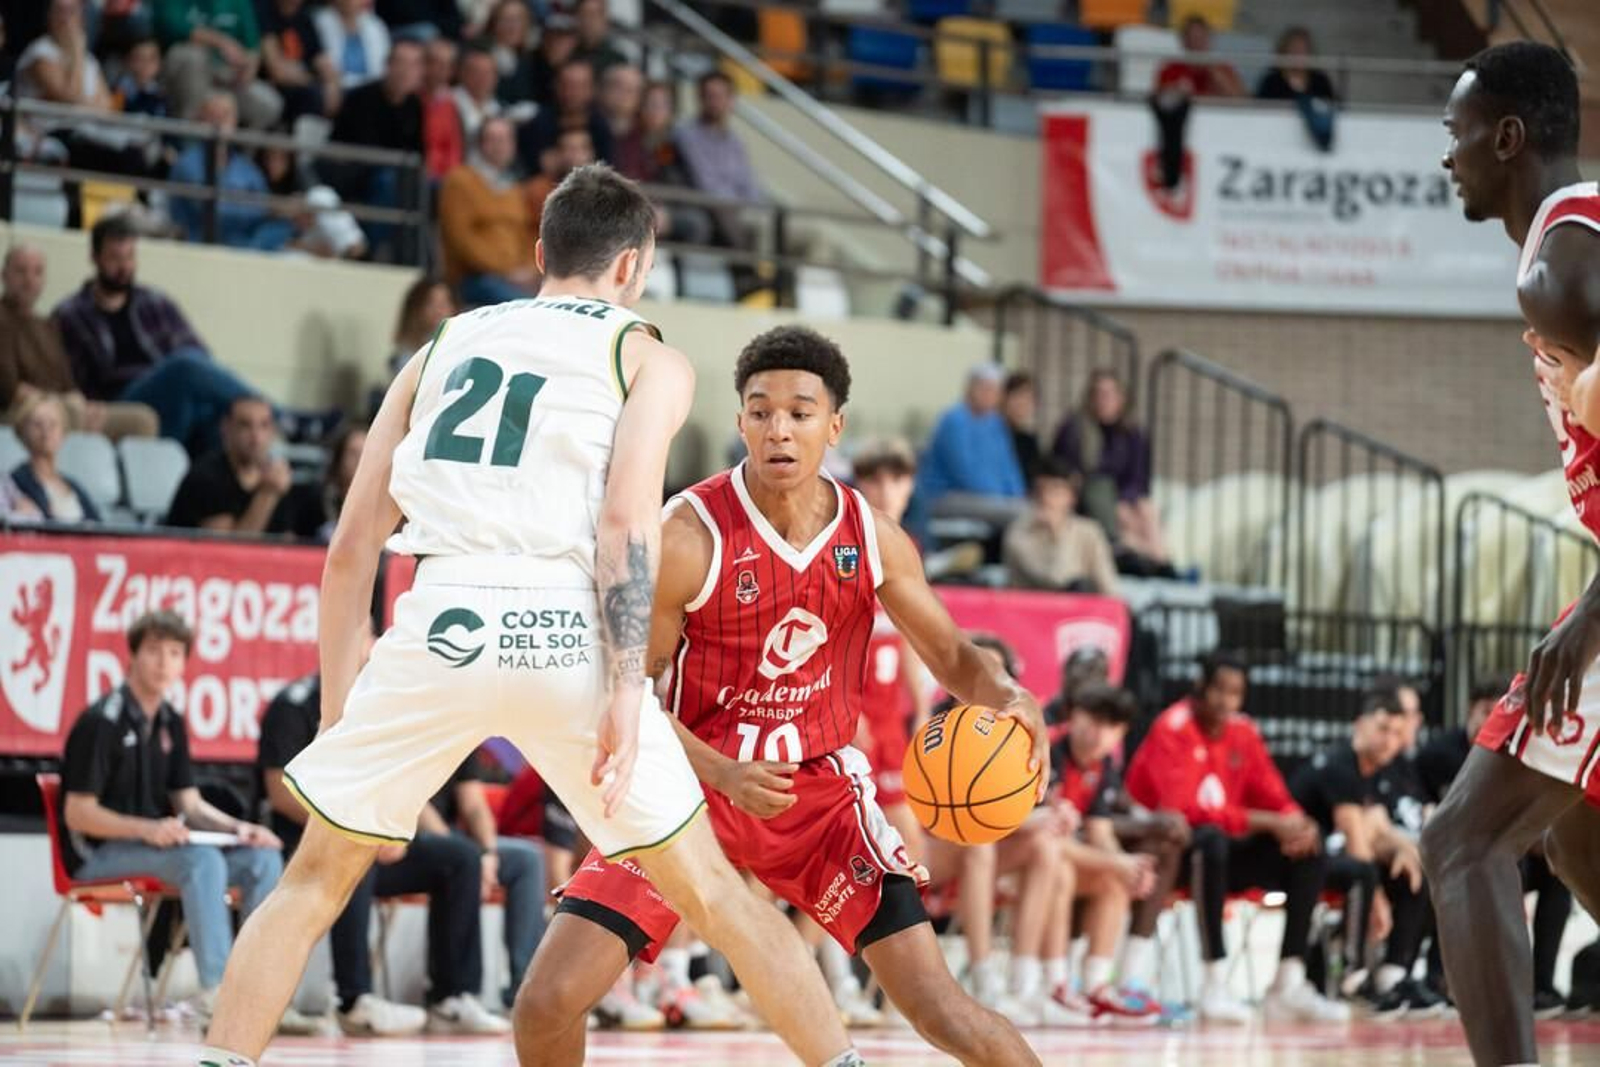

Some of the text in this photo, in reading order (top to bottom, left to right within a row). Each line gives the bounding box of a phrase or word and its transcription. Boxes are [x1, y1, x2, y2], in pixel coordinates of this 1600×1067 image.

[1217, 154, 1451, 224] Zaragoza
[423, 356, 548, 467] 21
[834, 546, 858, 556] LIGA
[501, 609, 588, 630] COSTA
[499, 632, 590, 650] DEL SOL
[737, 722, 804, 764] 10
